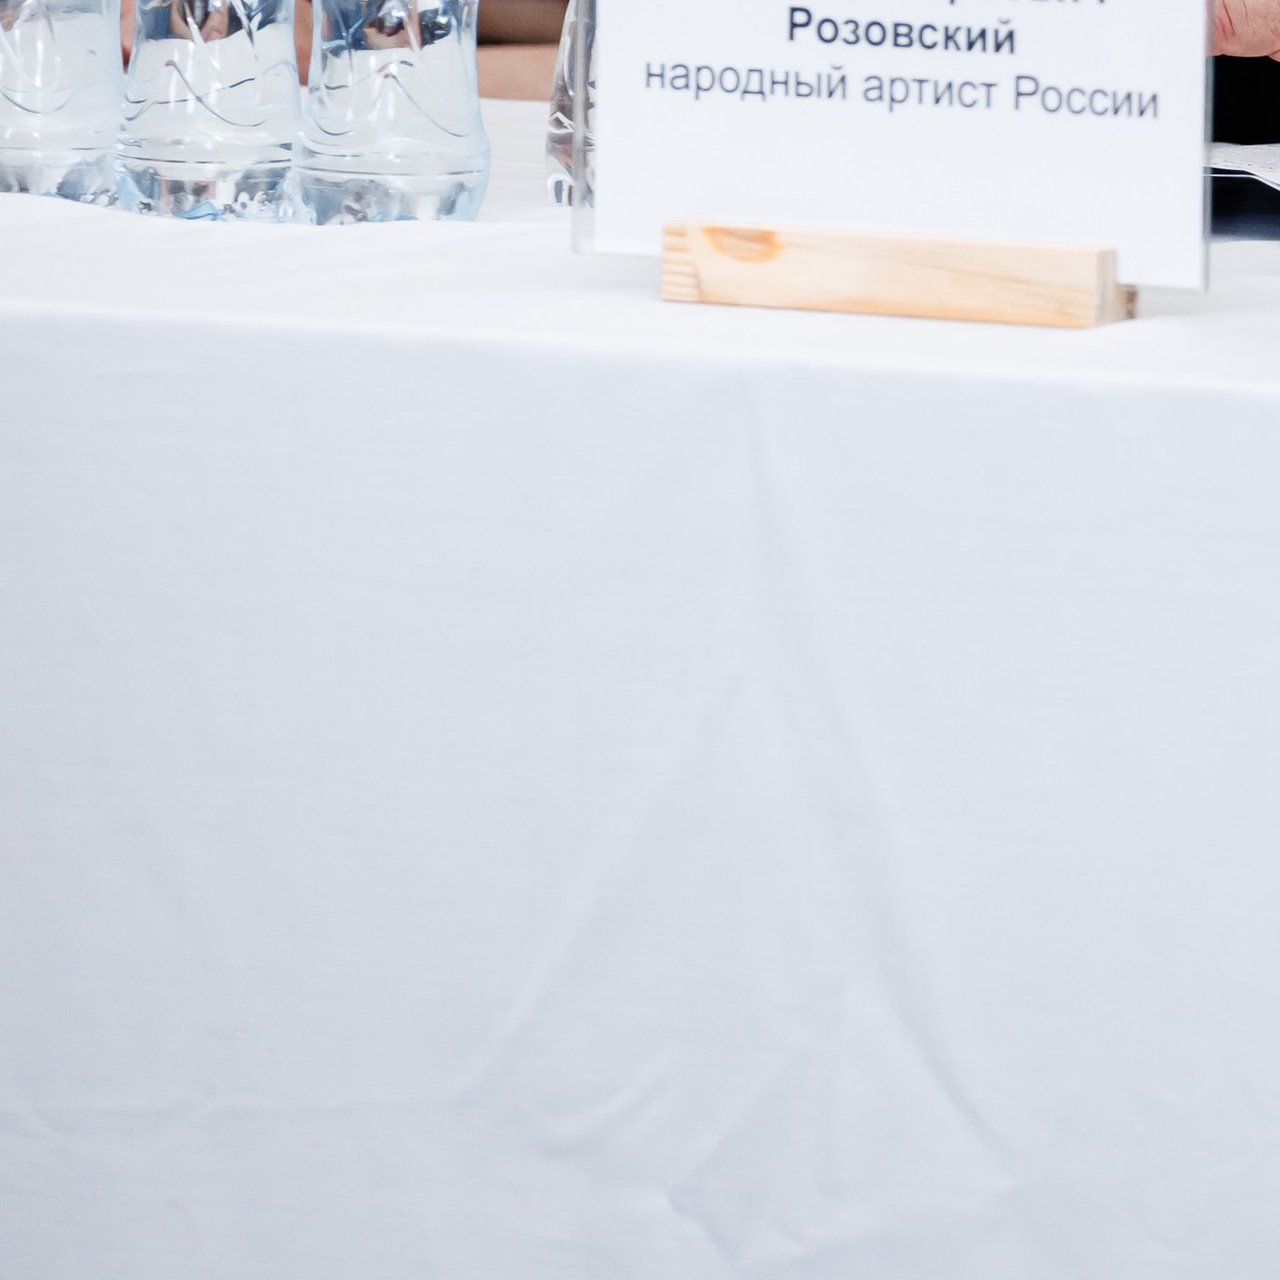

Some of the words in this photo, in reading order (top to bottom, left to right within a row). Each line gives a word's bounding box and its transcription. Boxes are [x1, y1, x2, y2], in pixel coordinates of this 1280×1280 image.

[787, 6, 1017, 54] Розовский
[645, 61, 848, 101] народный
[862, 74, 998, 112] артист
[1014, 76, 1159, 118] России
